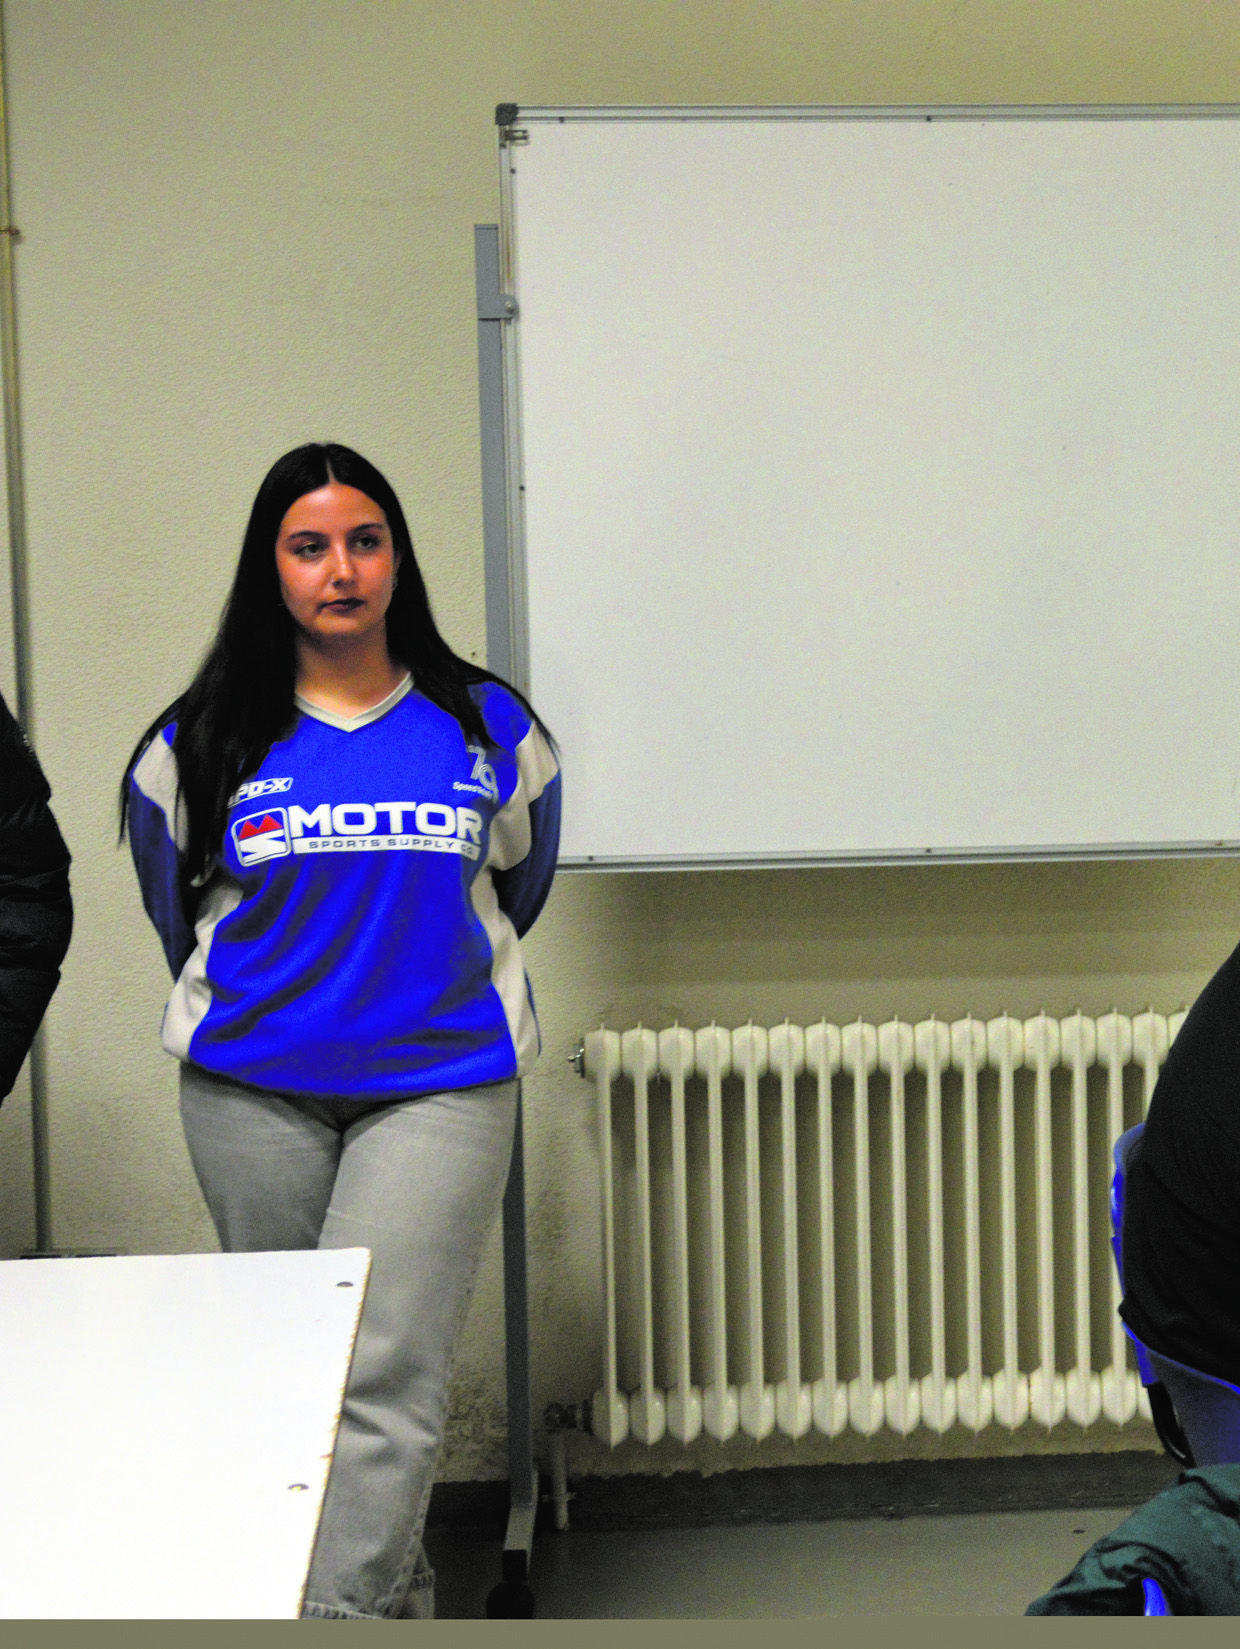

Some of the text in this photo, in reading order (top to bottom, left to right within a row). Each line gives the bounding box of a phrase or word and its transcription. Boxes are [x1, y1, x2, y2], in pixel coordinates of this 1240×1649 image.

[288, 801, 482, 845] MOTOR
[309, 839, 380, 849] SPORTS
[387, 838, 454, 849] SUPPLY
